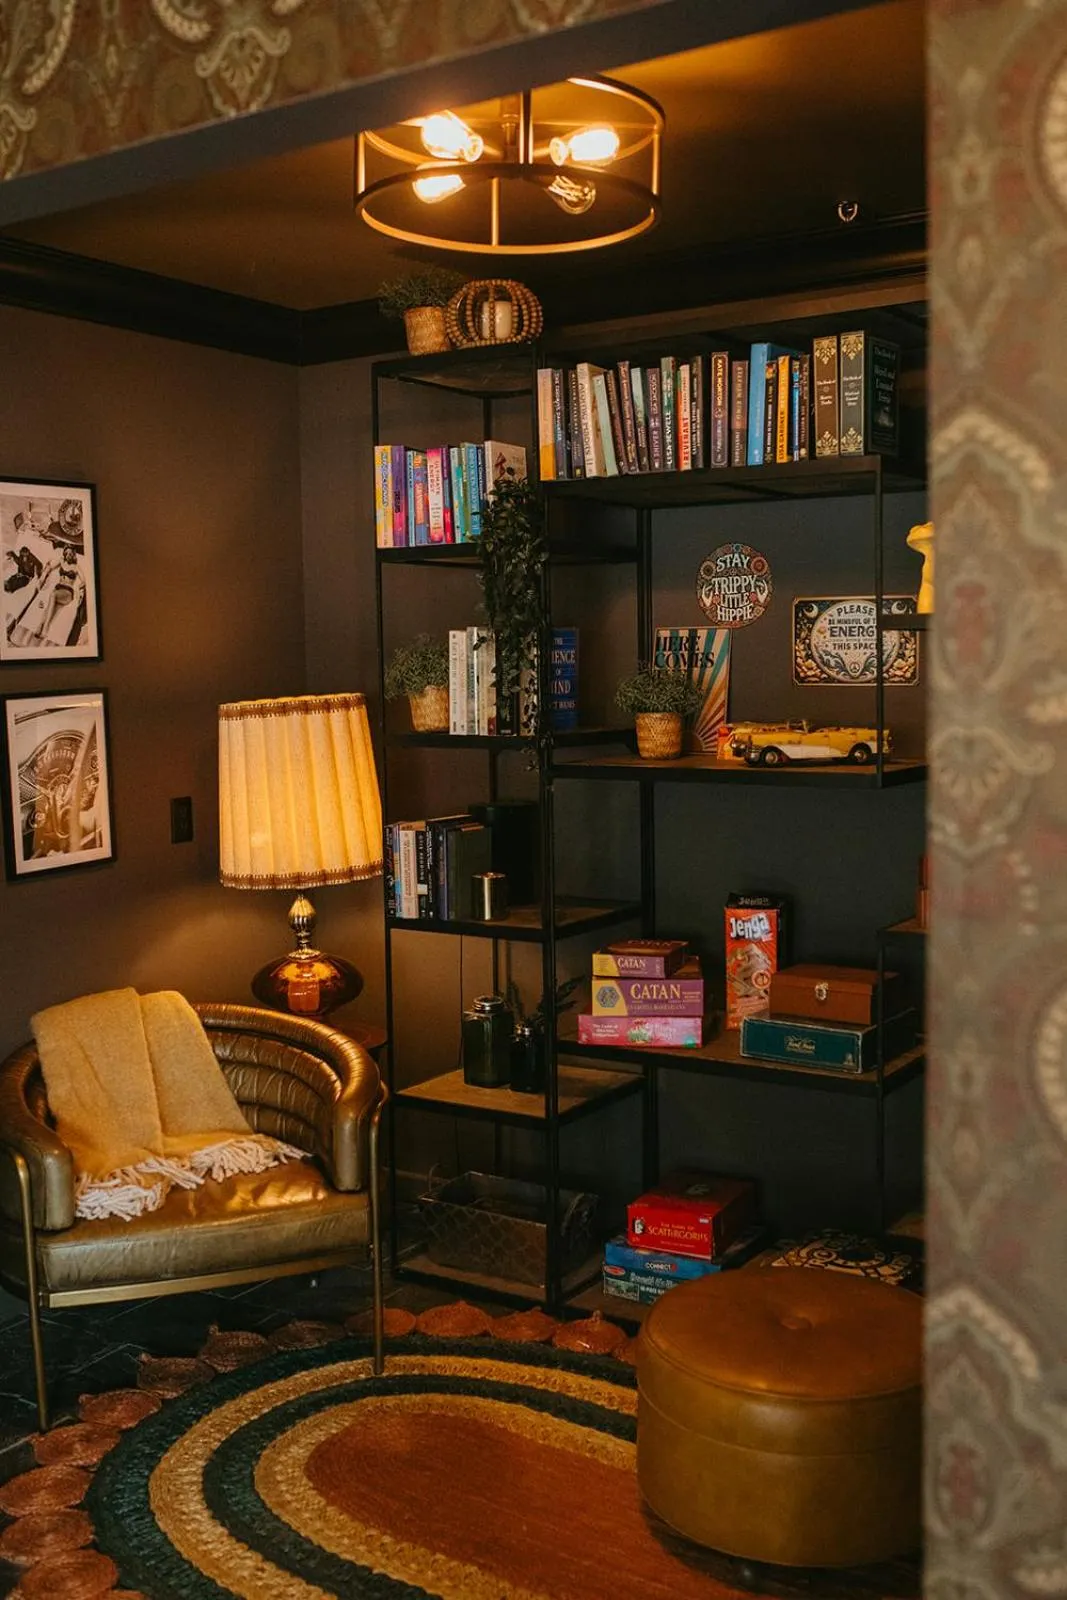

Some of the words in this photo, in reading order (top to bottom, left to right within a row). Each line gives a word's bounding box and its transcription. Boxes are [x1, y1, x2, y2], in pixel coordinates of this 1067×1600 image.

[717, 553, 750, 572] STAY
[711, 575, 757, 595] TRIPPY
[720, 592, 750, 608] LITTLE
[717, 603, 754, 621] HIPPIE
[836, 604, 875, 616] PLEASE
[829, 626, 877, 637] ENERG
[656, 636, 701, 652] HERE
[853, 642, 877, 650] SPAC
[551, 650, 576, 664] IENCE
[655, 652, 714, 669] COMES
[551, 680, 571, 694] IND
[730, 912, 770, 941] Jenga
[618, 958, 646, 968] CATAN
[630, 983, 681, 999] CATAN
[645, 1262, 671, 1271] CONNECT
